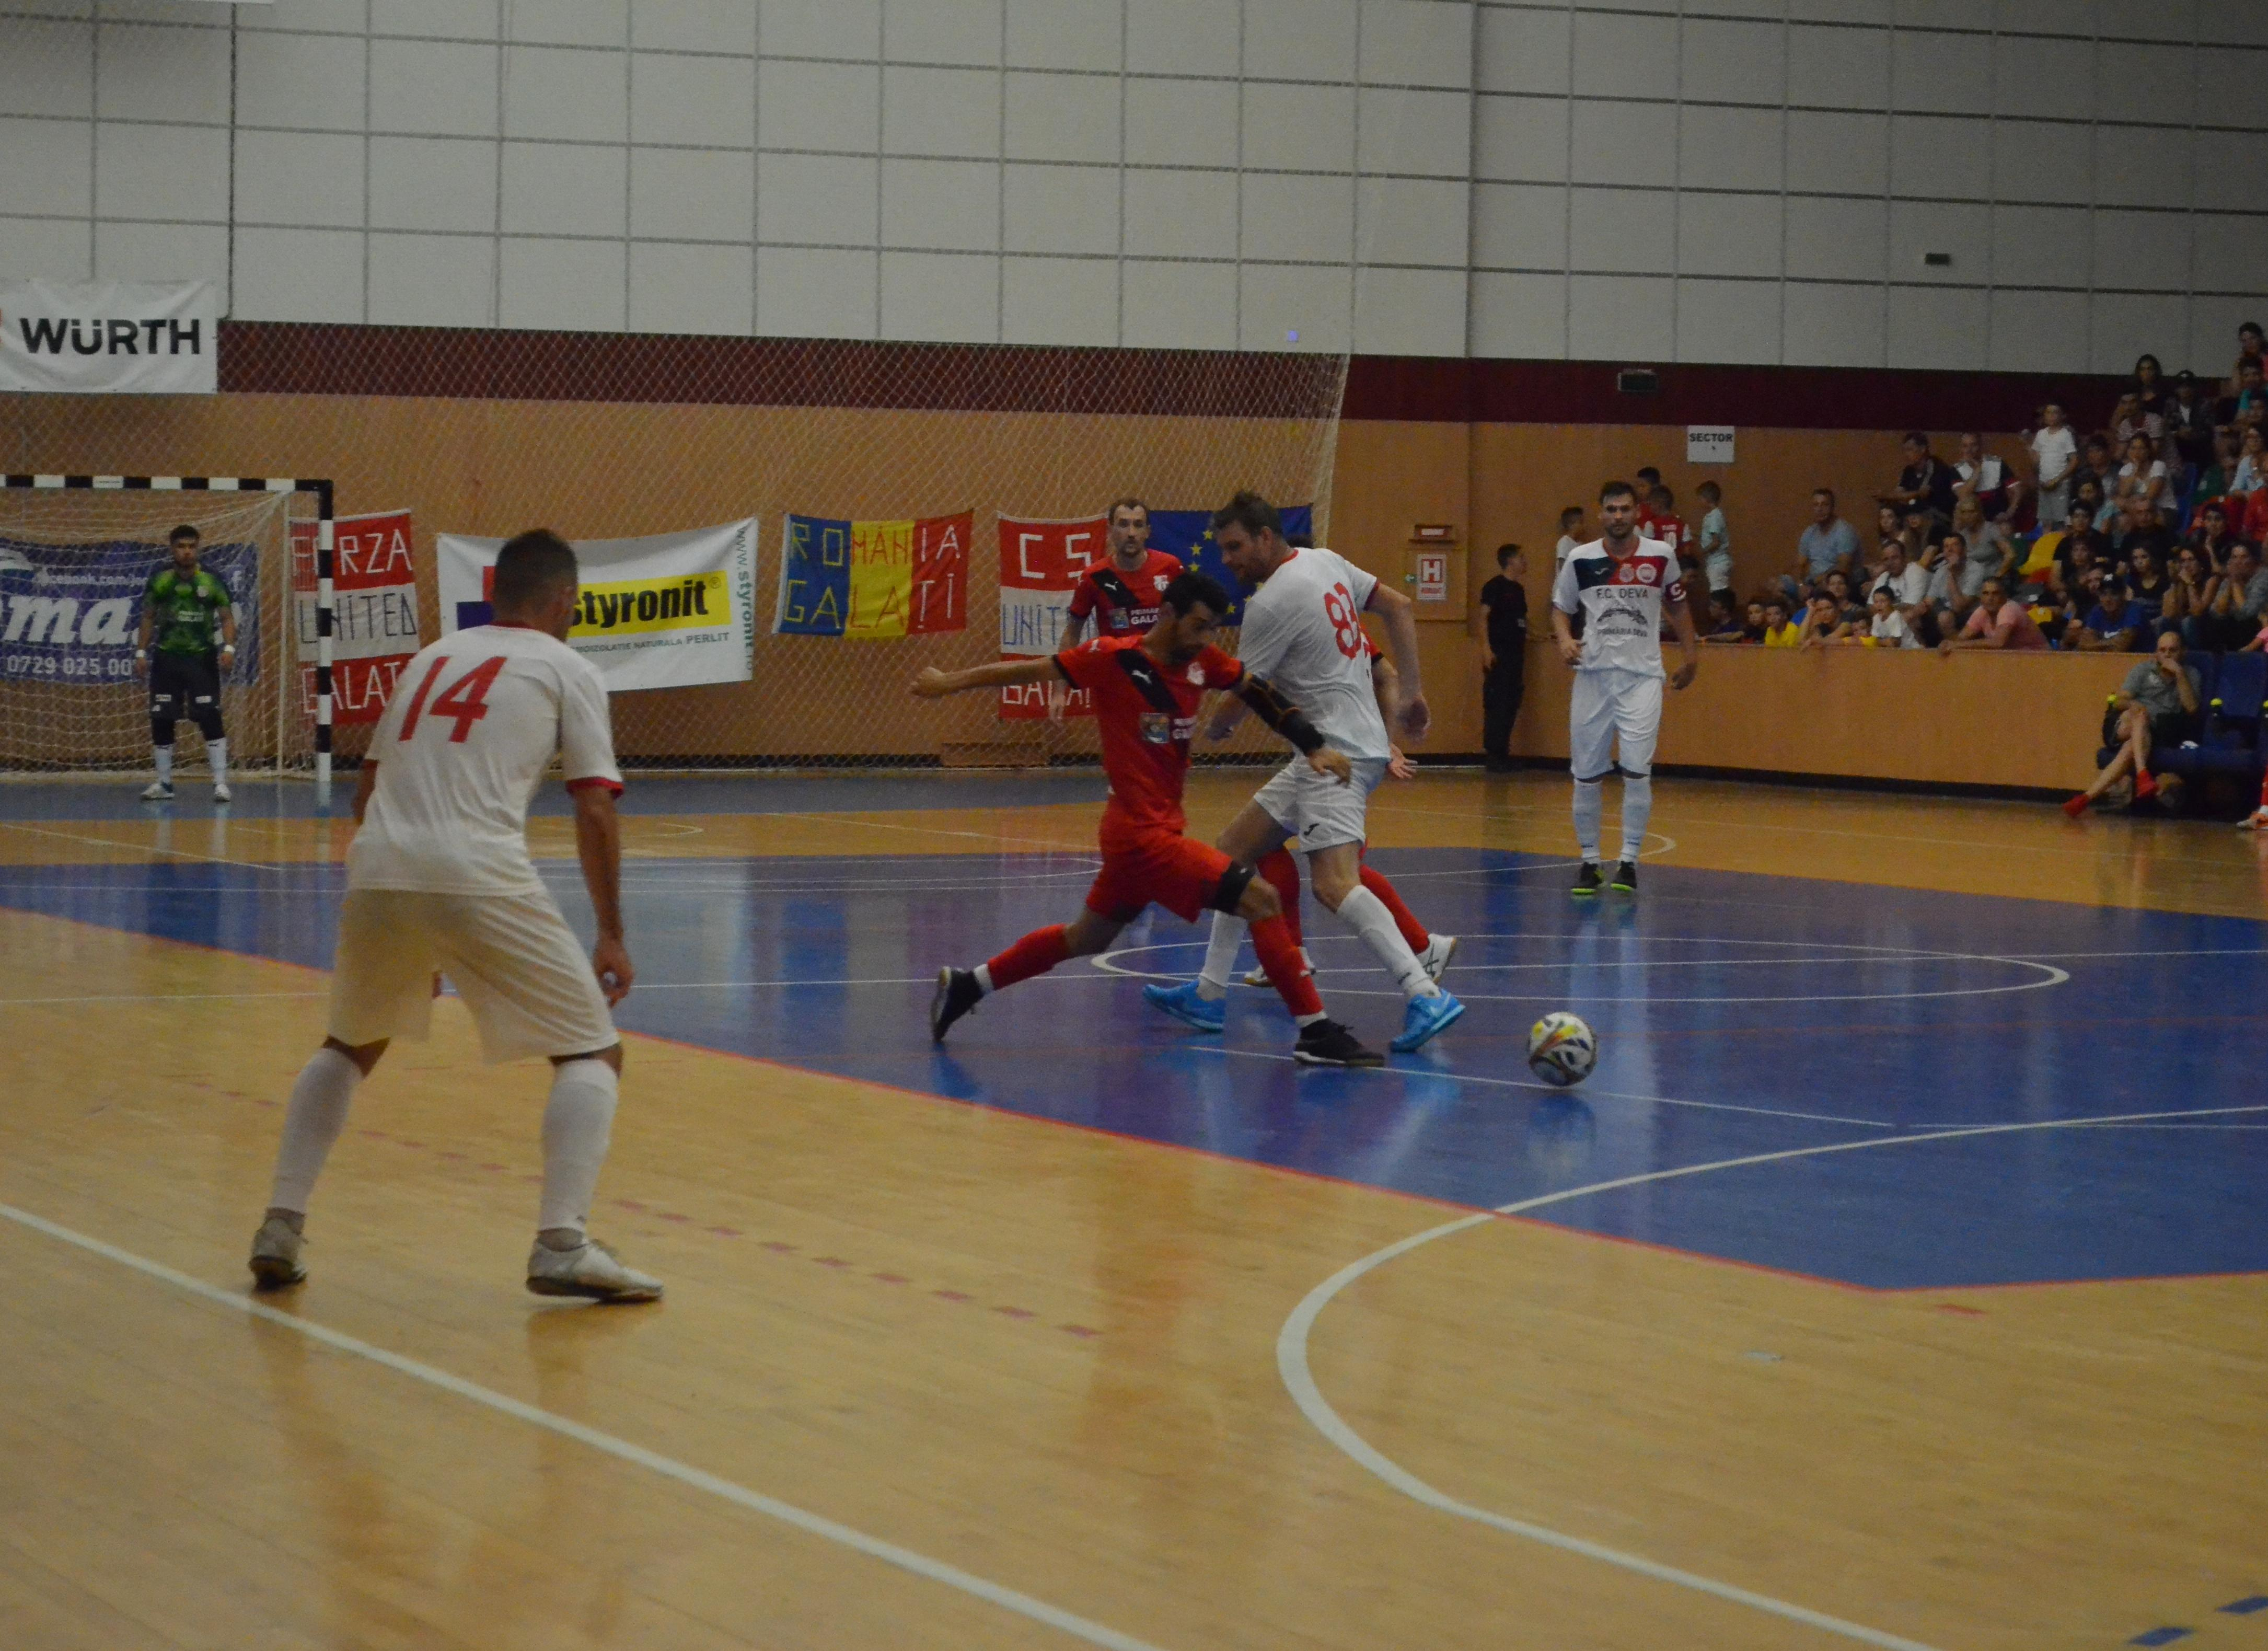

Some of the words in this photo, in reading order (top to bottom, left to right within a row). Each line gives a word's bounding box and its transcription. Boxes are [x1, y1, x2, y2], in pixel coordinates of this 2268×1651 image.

[19, 318, 200, 355] WÜRTH
[1688, 433, 1733, 442] SECTOR
[291, 529, 413, 575] FRZA
[1423, 561, 1441, 582] H
[1619, 588, 1648, 598] DEVA
[1130, 615, 1159, 625] GALA
[685, 632, 730, 644] PERLIT
[398, 656, 507, 743] 14
